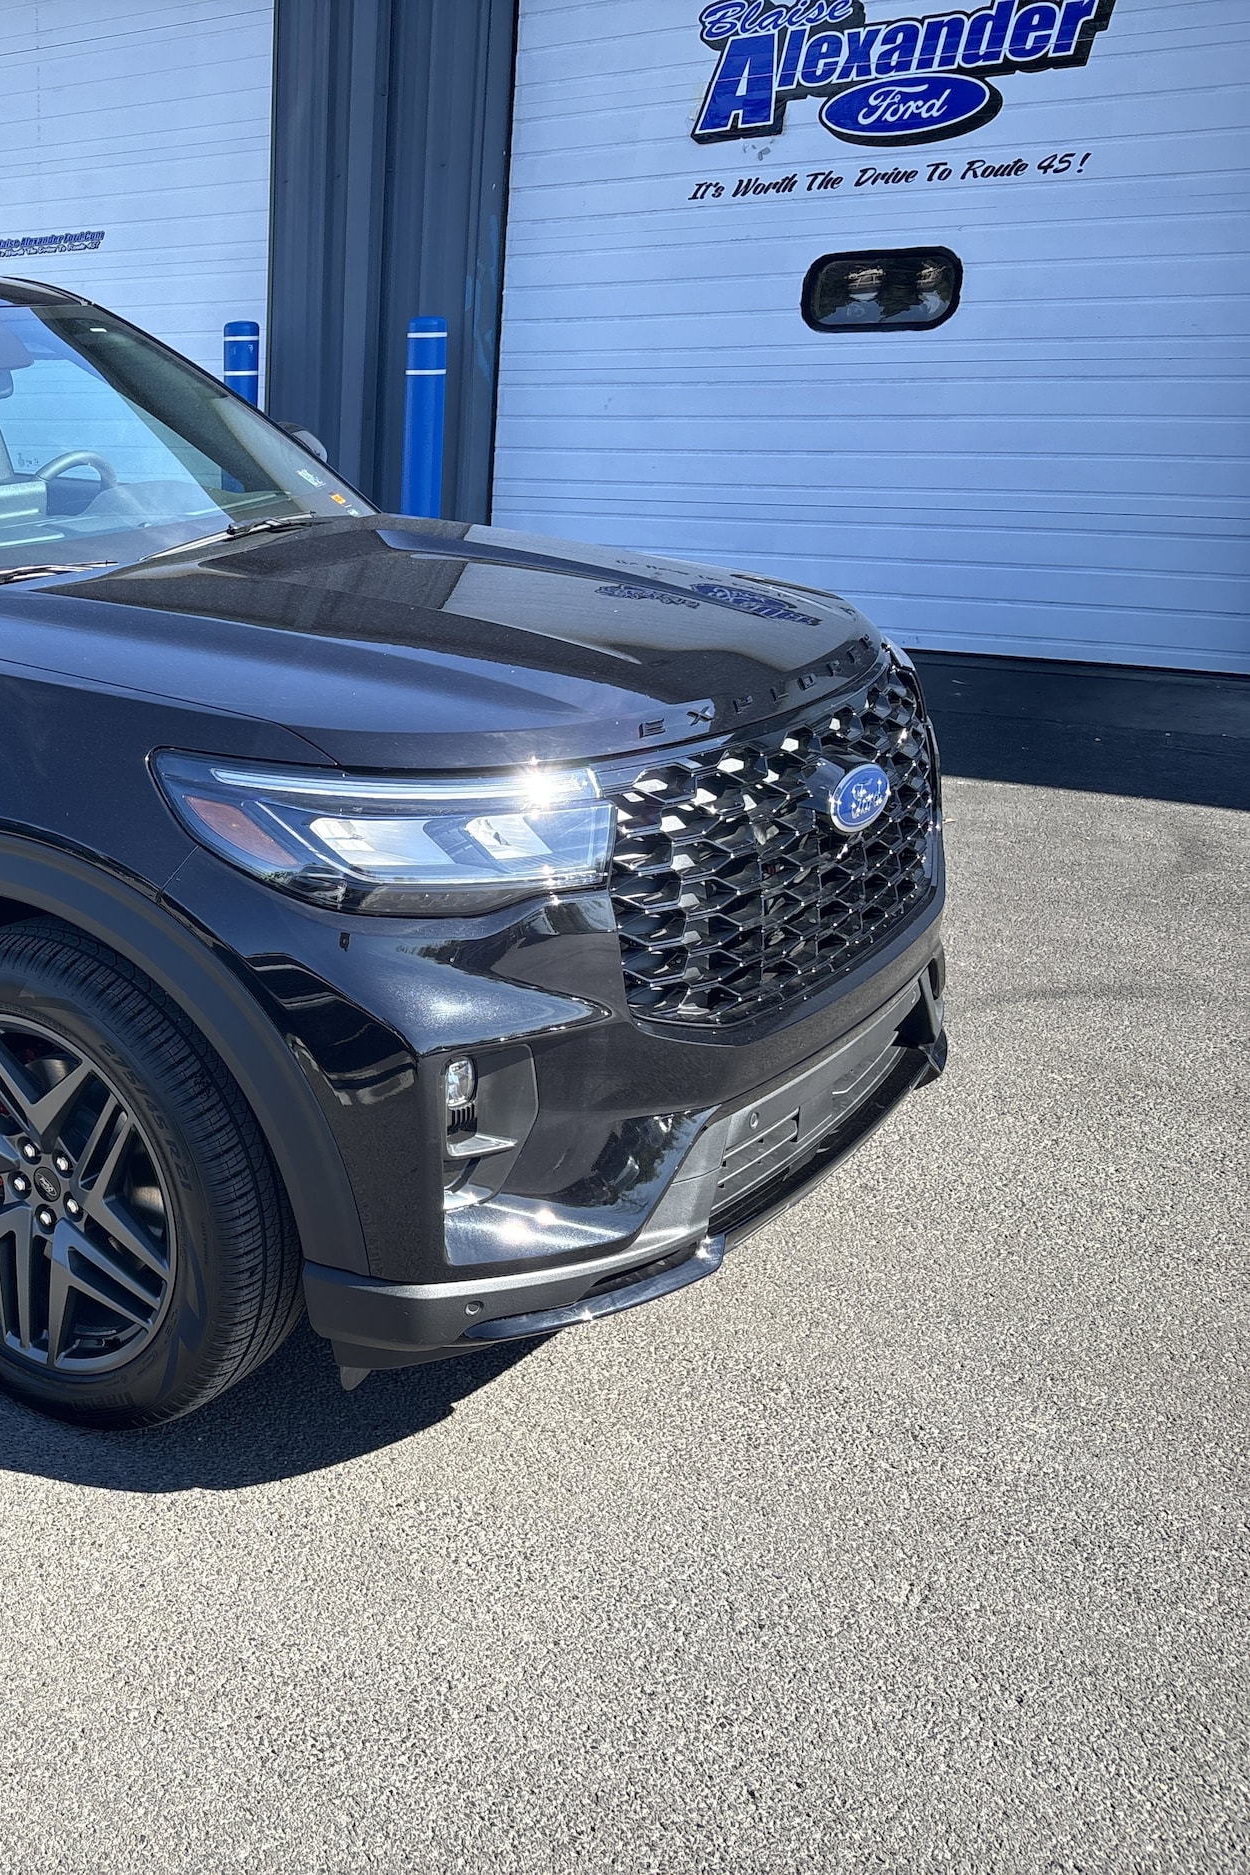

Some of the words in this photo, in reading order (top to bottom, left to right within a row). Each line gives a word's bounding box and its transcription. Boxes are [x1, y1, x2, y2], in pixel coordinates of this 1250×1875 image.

[700, 0, 853, 41] Blaise
[695, 0, 1096, 134] Alexander
[857, 84, 952, 125] Ford
[688, 181, 725, 200] It's
[732, 174, 798, 198] Worth
[806, 170, 844, 192] The
[853, 167, 919, 187] Drive
[926, 162, 952, 182] To
[960, 158, 1029, 180] Route
[639, 633, 875, 738] EXPLORER
